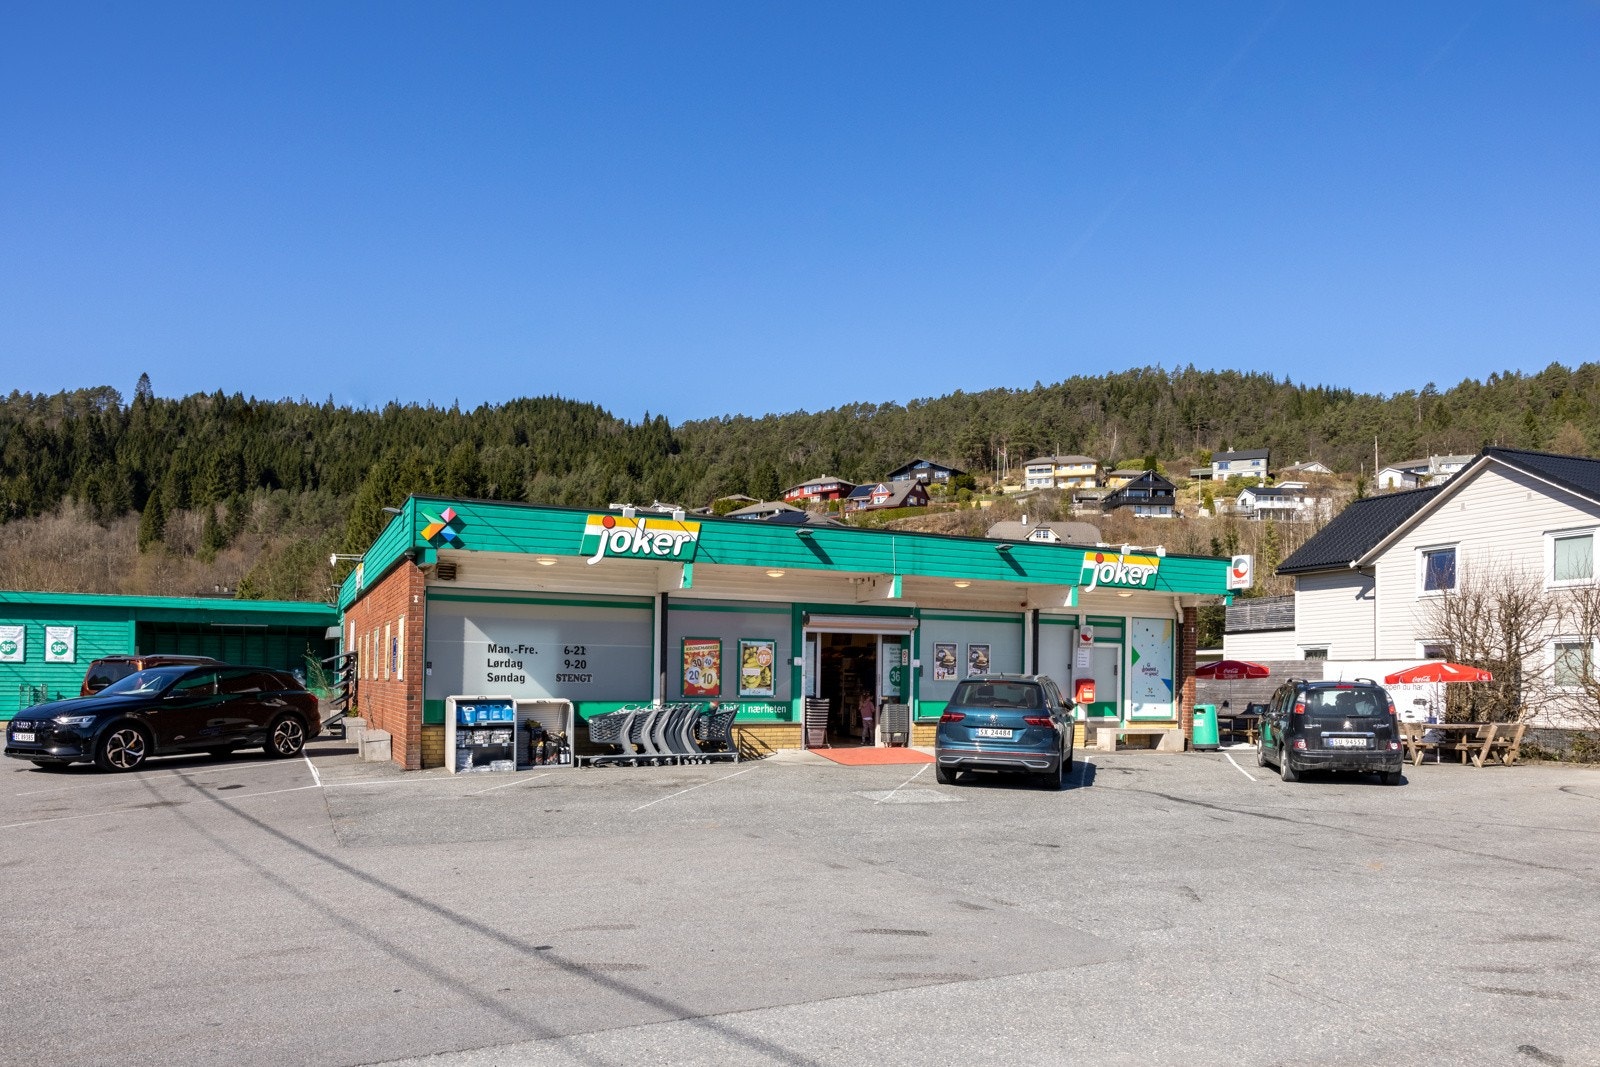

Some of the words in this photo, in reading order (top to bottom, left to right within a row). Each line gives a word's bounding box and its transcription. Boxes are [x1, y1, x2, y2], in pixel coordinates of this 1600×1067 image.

[587, 515, 691, 565] joker
[1084, 552, 1155, 593] joker
[487, 644, 539, 655] Man.-Fre.
[564, 645, 586, 655] 6-21
[487, 658, 523, 670] Lørdag
[564, 659, 587, 670] 9-20
[692, 657, 702, 668] 30
[487, 672, 526, 684] Søndag
[555, 673, 593, 683] STENGT
[688, 669, 700, 681] 20
[701, 672, 713, 685] 10
[742, 703, 746, 714] i
[748, 703, 787, 714] nærheten
[980, 729, 989, 737] SX
[990, 729, 1012, 738] 24484
